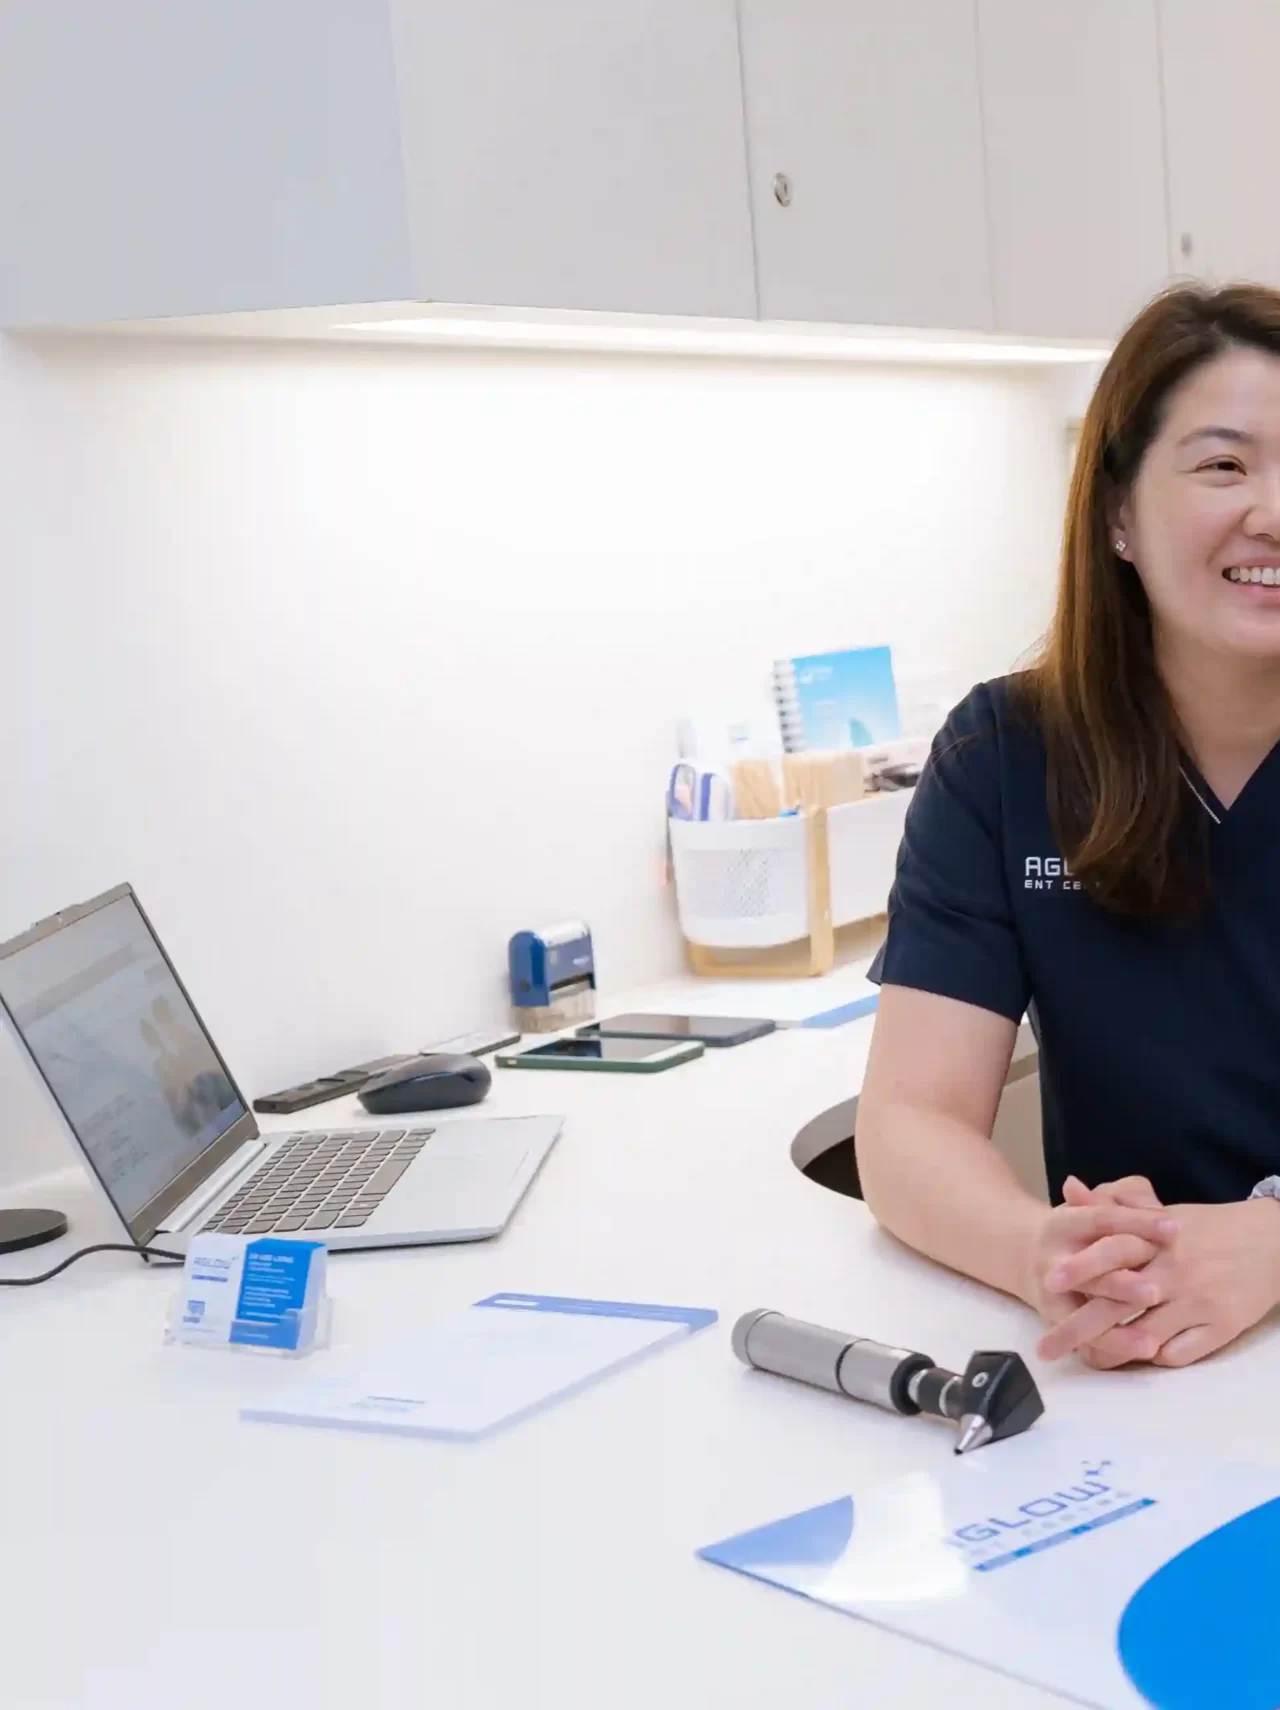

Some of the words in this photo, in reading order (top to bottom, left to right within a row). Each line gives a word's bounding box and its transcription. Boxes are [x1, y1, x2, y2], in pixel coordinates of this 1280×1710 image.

[1024, 856, 1075, 877] AGL
[1024, 880, 1054, 890] ENT
[946, 1480, 1111, 1546] GLOW
